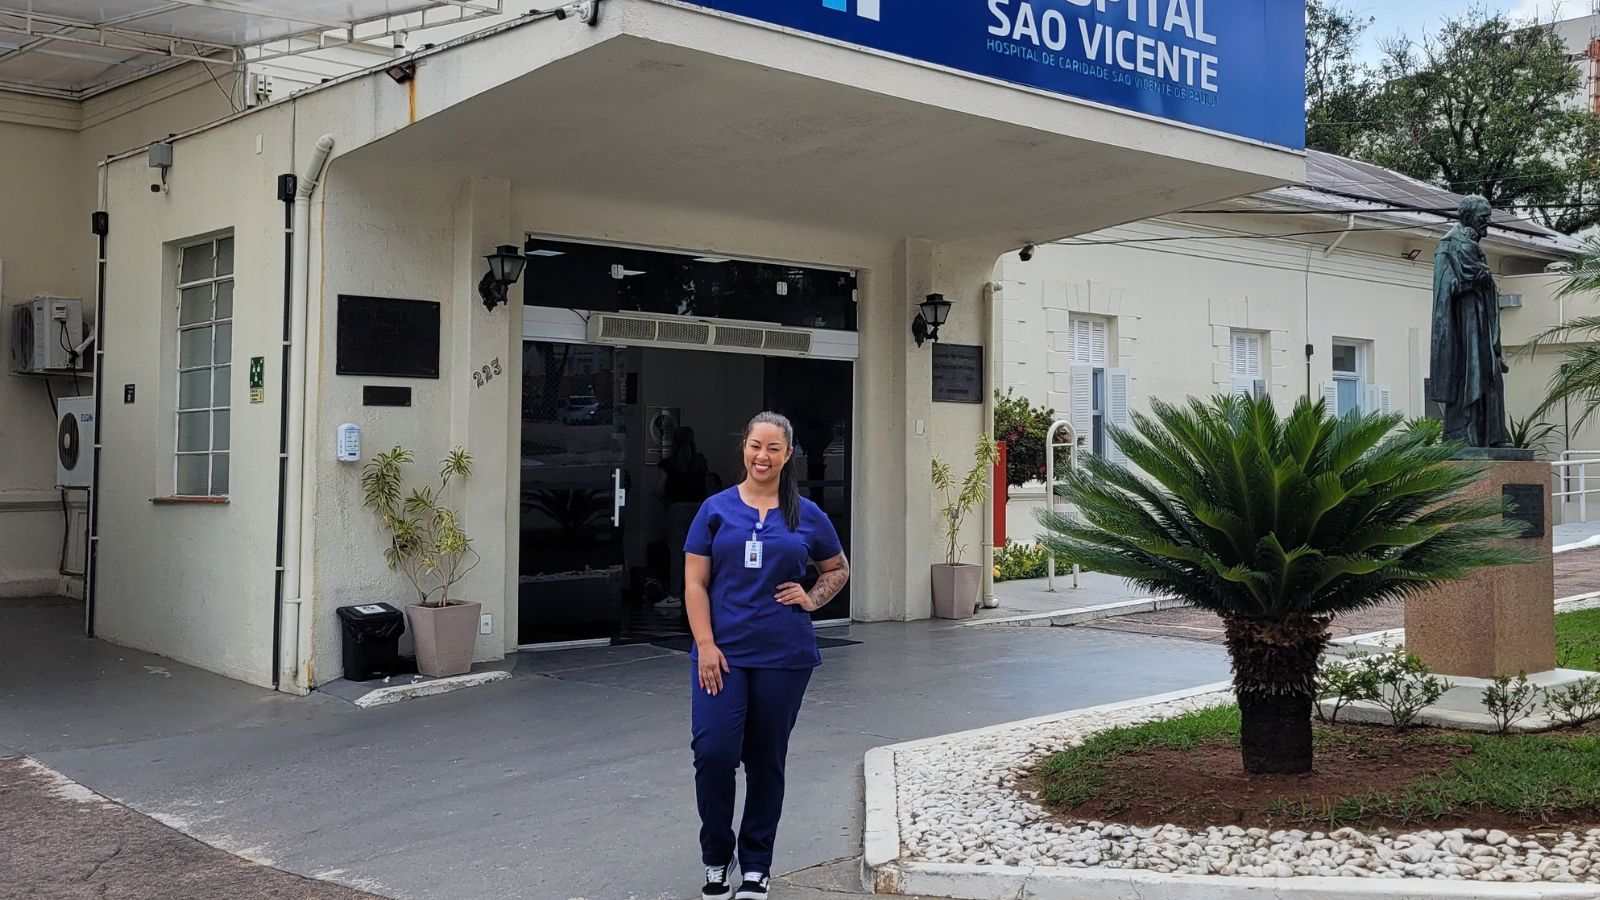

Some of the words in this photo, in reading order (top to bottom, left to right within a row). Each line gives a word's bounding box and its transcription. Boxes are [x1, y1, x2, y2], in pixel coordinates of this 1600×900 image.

[986, 39, 1039, 62] HOSPITAL
[1042, 51, 1055, 66] DE
[1058, 56, 1110, 80] CARIDADE
[1078, 17, 1218, 92] VICENTE
[473, 357, 502, 389] 223
